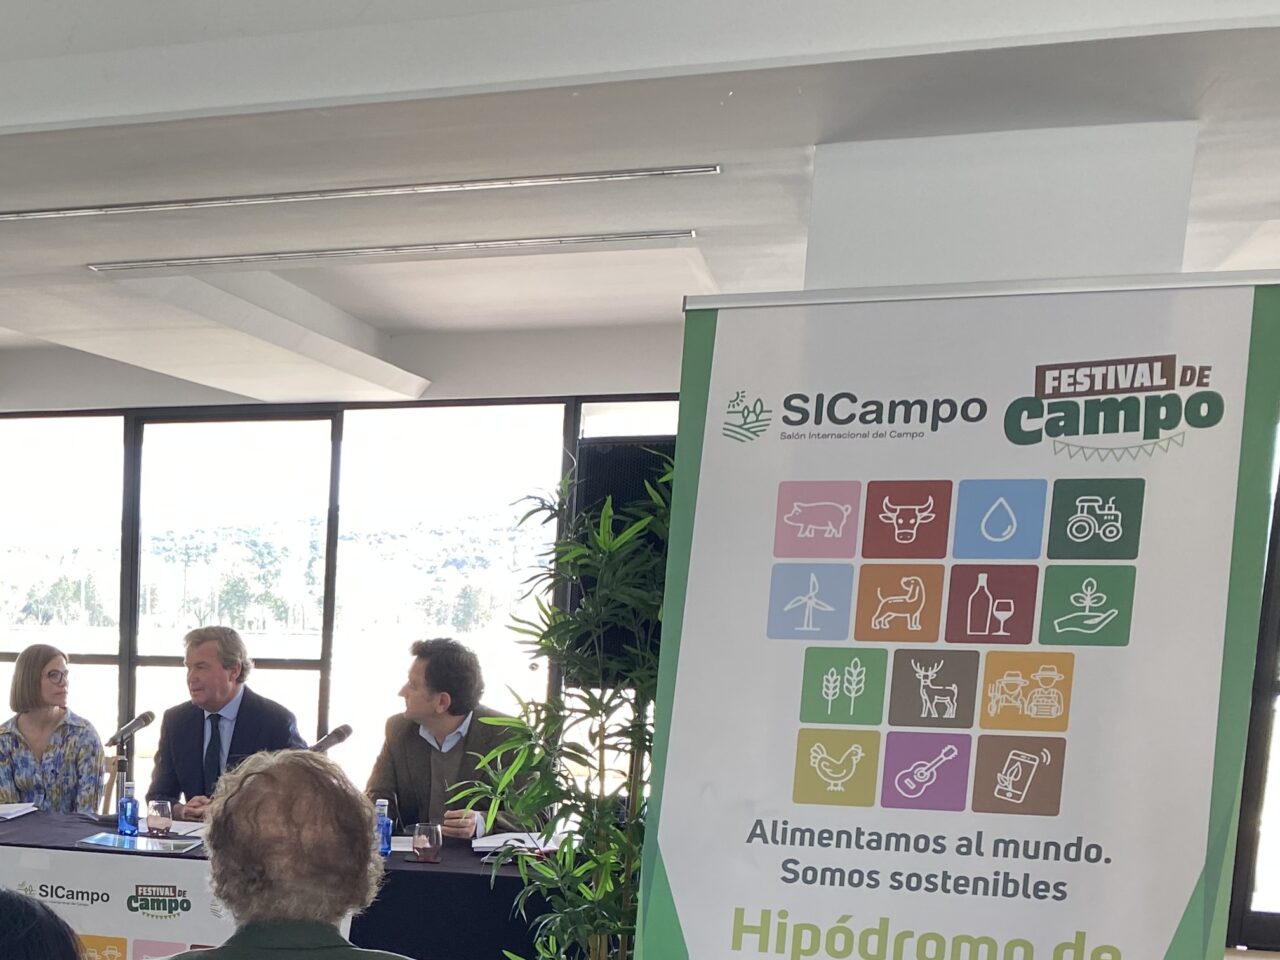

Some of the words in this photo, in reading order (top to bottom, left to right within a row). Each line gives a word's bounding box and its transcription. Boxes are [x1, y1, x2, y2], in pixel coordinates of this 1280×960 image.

[1043, 361, 1167, 395] FESTIVAL
[1178, 364, 1212, 388] DE
[781, 391, 988, 431] SICampo
[1003, 390, 1225, 446] Campo
[808, 431, 870, 439] Internacional
[872, 431, 887, 439] del
[889, 430, 925, 440] Campo
[746, 818, 946, 856] Alimentamos
[955, 830, 984, 857] al
[992, 835, 1112, 864] mundo.
[38, 885, 110, 904] SICampo
[138, 887, 175, 896] FESTIVAL
[780, 859, 880, 889] Somos
[889, 867, 1068, 901] sostenibles
[127, 895, 191, 914] Campo
